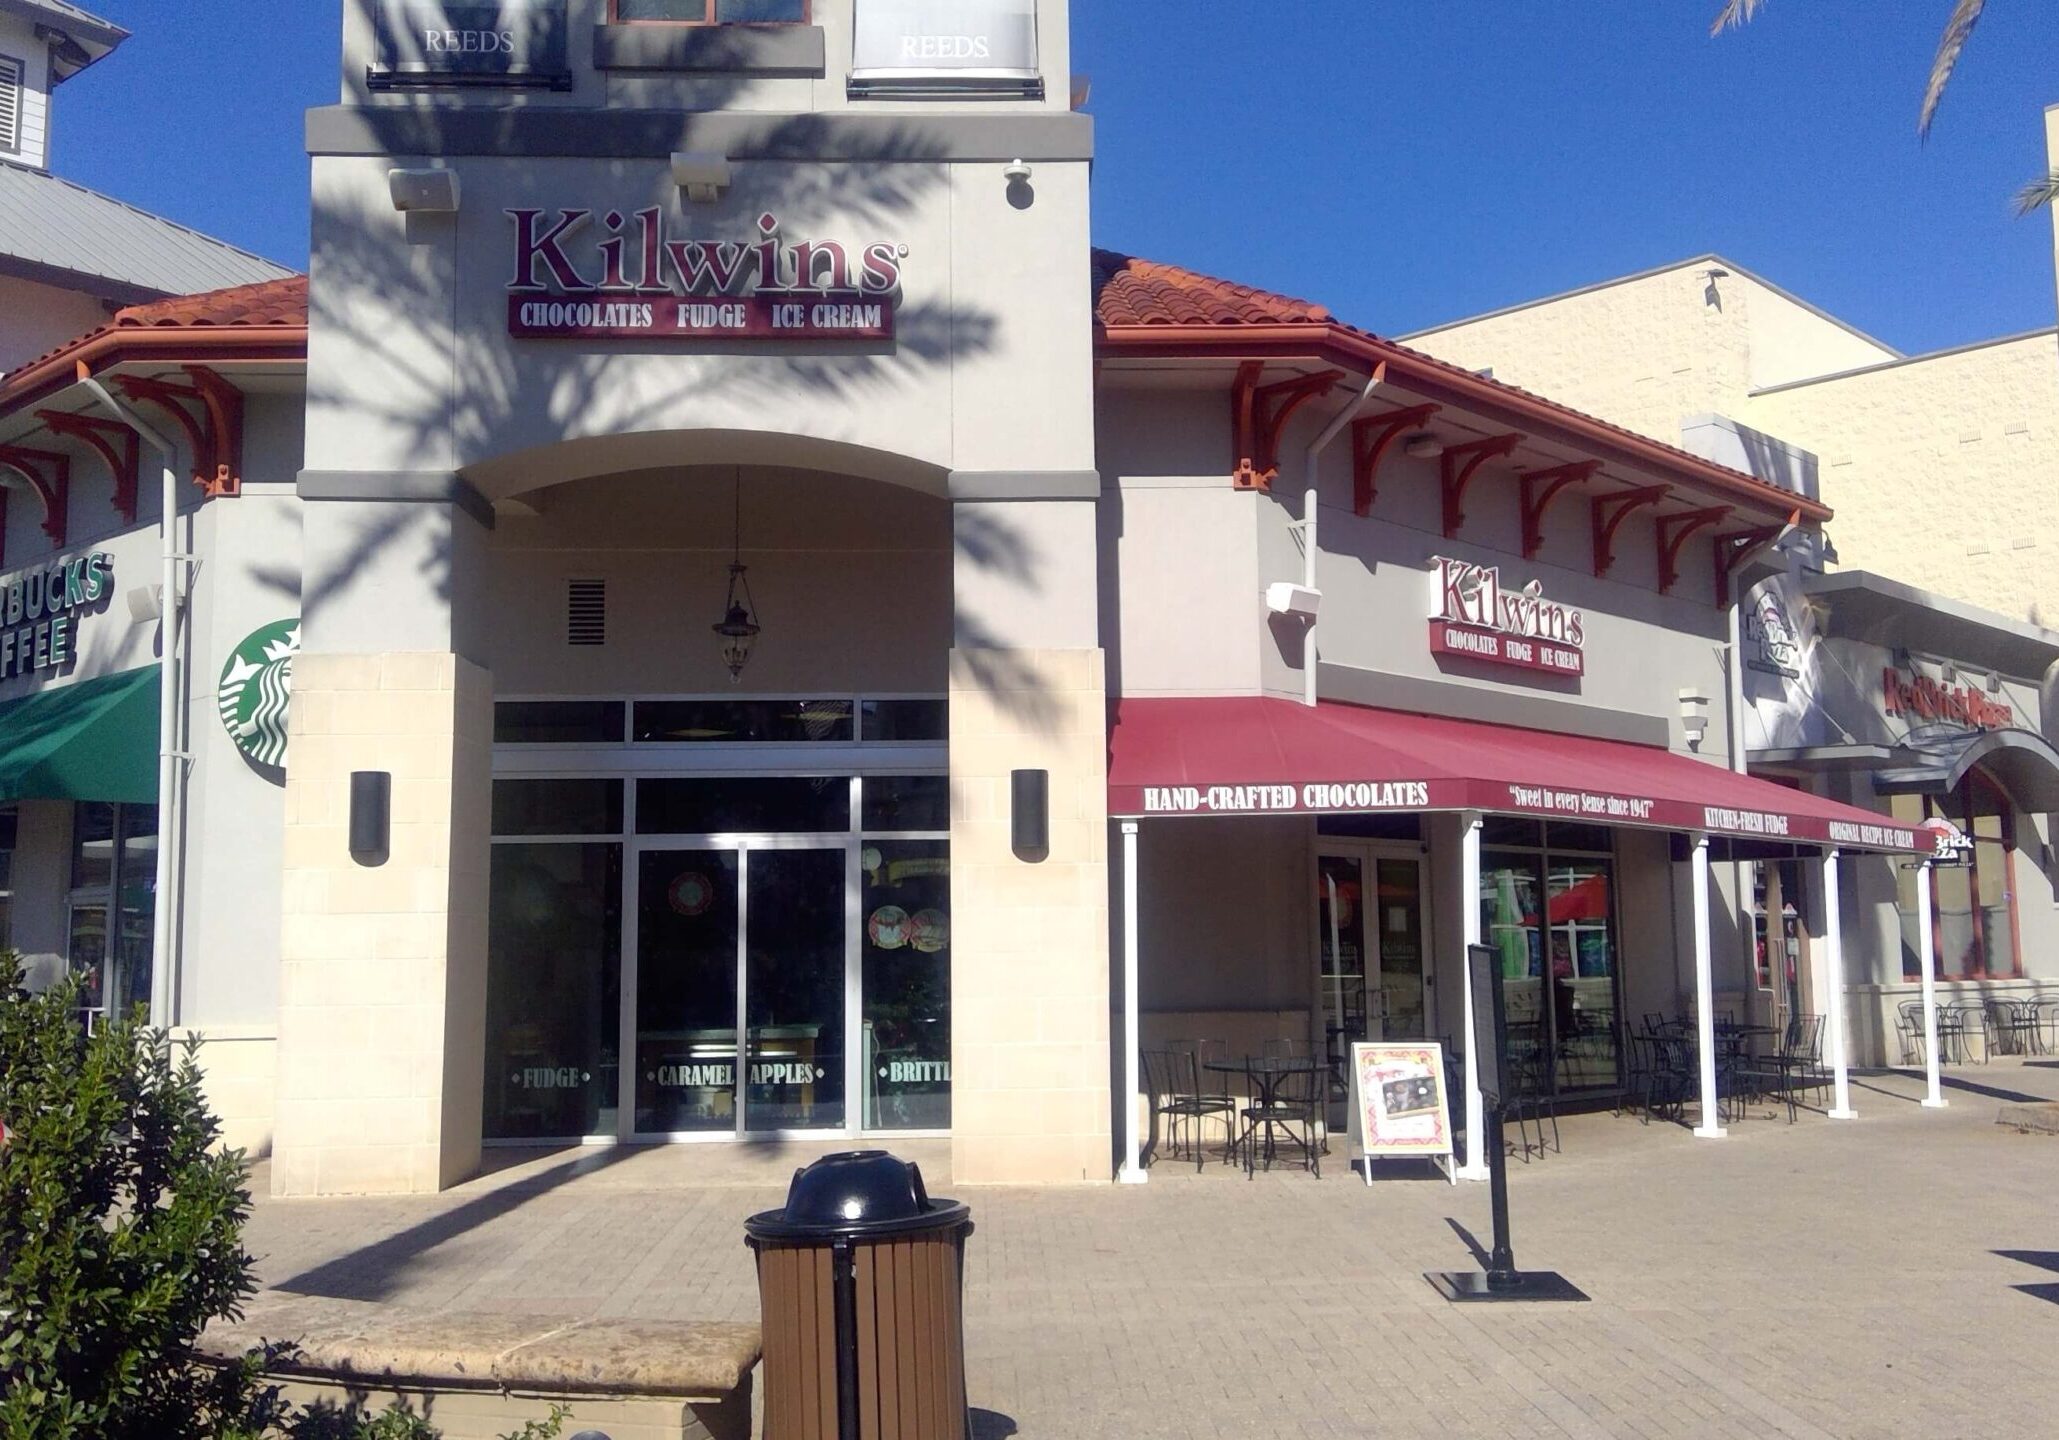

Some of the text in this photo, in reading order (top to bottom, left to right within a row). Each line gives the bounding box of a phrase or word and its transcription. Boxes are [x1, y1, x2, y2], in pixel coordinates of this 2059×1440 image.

[424, 30, 515, 53] REEDS
[900, 35, 990, 58] REEDS
[504, 206, 901, 294] Kilwins
[520, 302, 882, 328] CHOCOLATES FUDGE ICE CREAM
[1430, 555, 1585, 648] Kilwins
[1446, 629, 1581, 670] CHOCOLATES FUDGE ICE CREAM
[1144, 782, 1429, 811] HAND-CRAFTED CHOCOLATES
[1543, 789, 1553, 809] in
[1555, 792, 1580, 814] every
[1581, 793, 1606, 814] Sense
[1607, 796, 1629, 816] since
[1704, 807, 1789, 835] KITCHEN-FRESH FUDGE
[1829, 821, 1914, 848] ORIGINAL RECIPE ICE CREAM
[523, 1067, 579, 1089] FUDGE
[657, 1062, 814, 1086] CARAMEL APPLES
